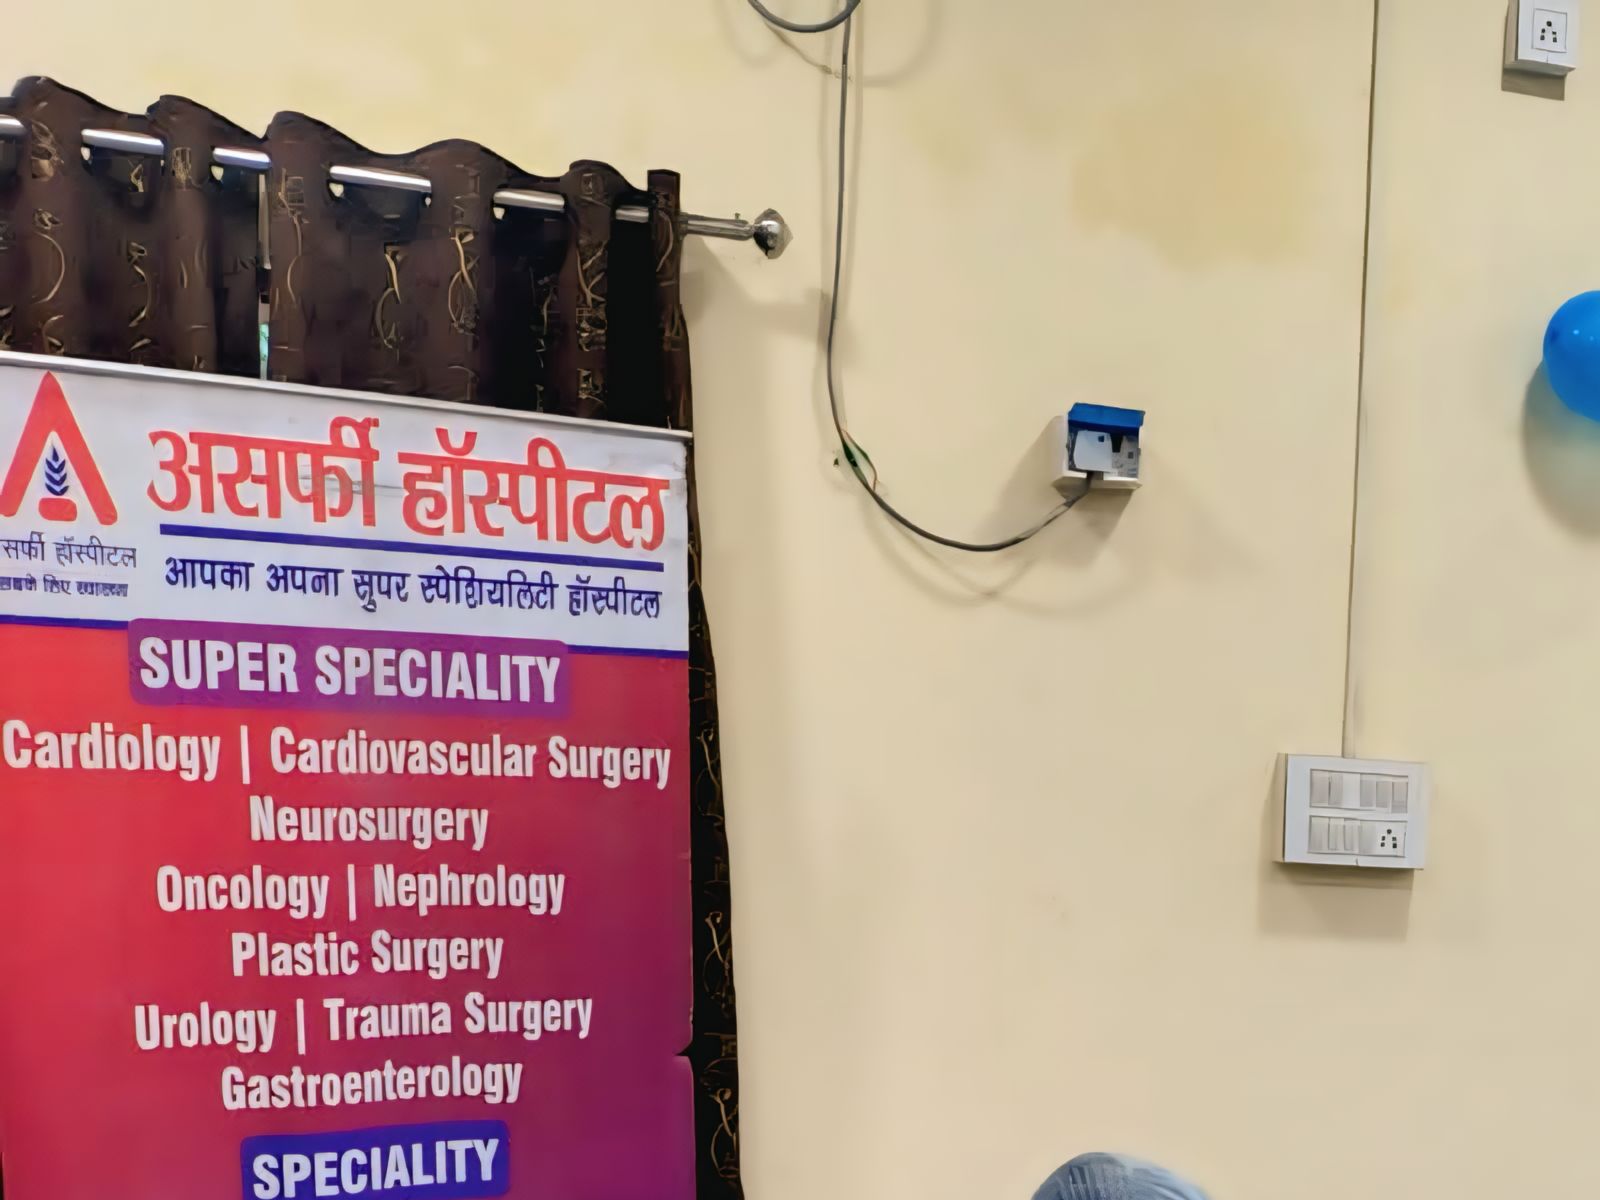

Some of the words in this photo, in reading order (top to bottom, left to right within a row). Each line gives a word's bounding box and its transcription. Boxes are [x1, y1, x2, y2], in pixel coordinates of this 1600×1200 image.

[147, 416, 380, 527] असर्फी
[397, 427, 670, 551] हॉस्पीटल
[0, 530, 45, 561] सर्फी
[166, 557, 255, 591] आपका
[267, 564, 344, 596] अपना
[352, 570, 411, 612] सुपर
[566, 575, 662, 618] हॉस्पीटल
[140, 637, 299, 692] SUPER
[315, 645, 560, 702] SPECIALITY
[3, 720, 220, 781] Cardiology
[271, 726, 537, 776] Cardiovascular
[548, 736, 670, 789] Surgery
[250, 795, 488, 851] Neurosurgery
[157, 865, 329, 919] Oncology
[374, 864, 565, 916] Nephrology
[232, 932, 359, 976] Plastic
[372, 929, 503, 979] Surgery
[135, 1002, 276, 1053] Urology
[323, 998, 451, 1040] Trauma
[465, 992, 592, 1040] Surgery
[222, 1056, 522, 1110] Gastroenterology
[253, 1139, 498, 1199] SPECIALITY
